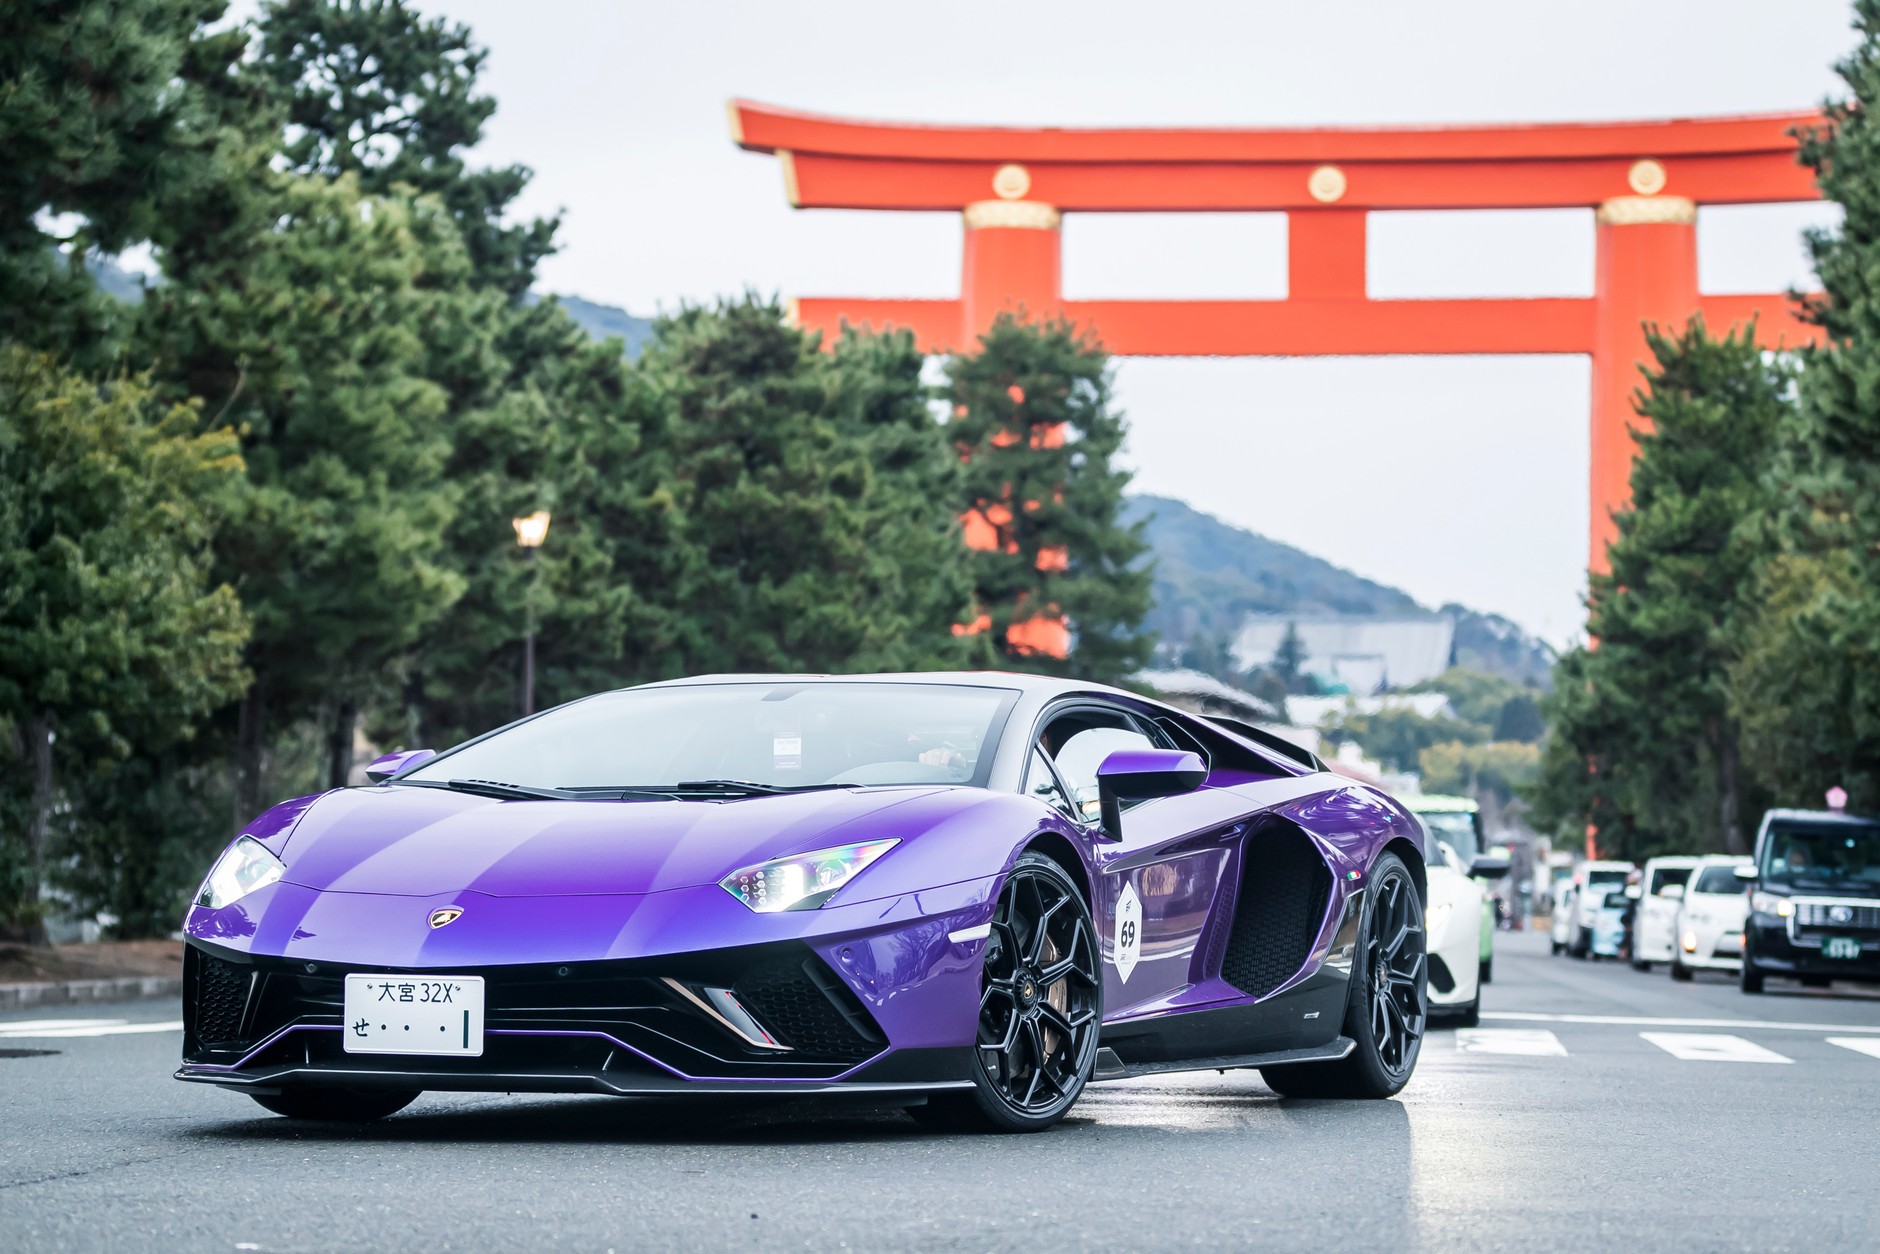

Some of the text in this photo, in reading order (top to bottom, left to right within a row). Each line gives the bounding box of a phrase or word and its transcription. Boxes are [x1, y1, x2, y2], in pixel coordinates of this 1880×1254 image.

[1121, 920, 1135, 948] 69
[378, 982, 453, 1003] 大宮 32X
